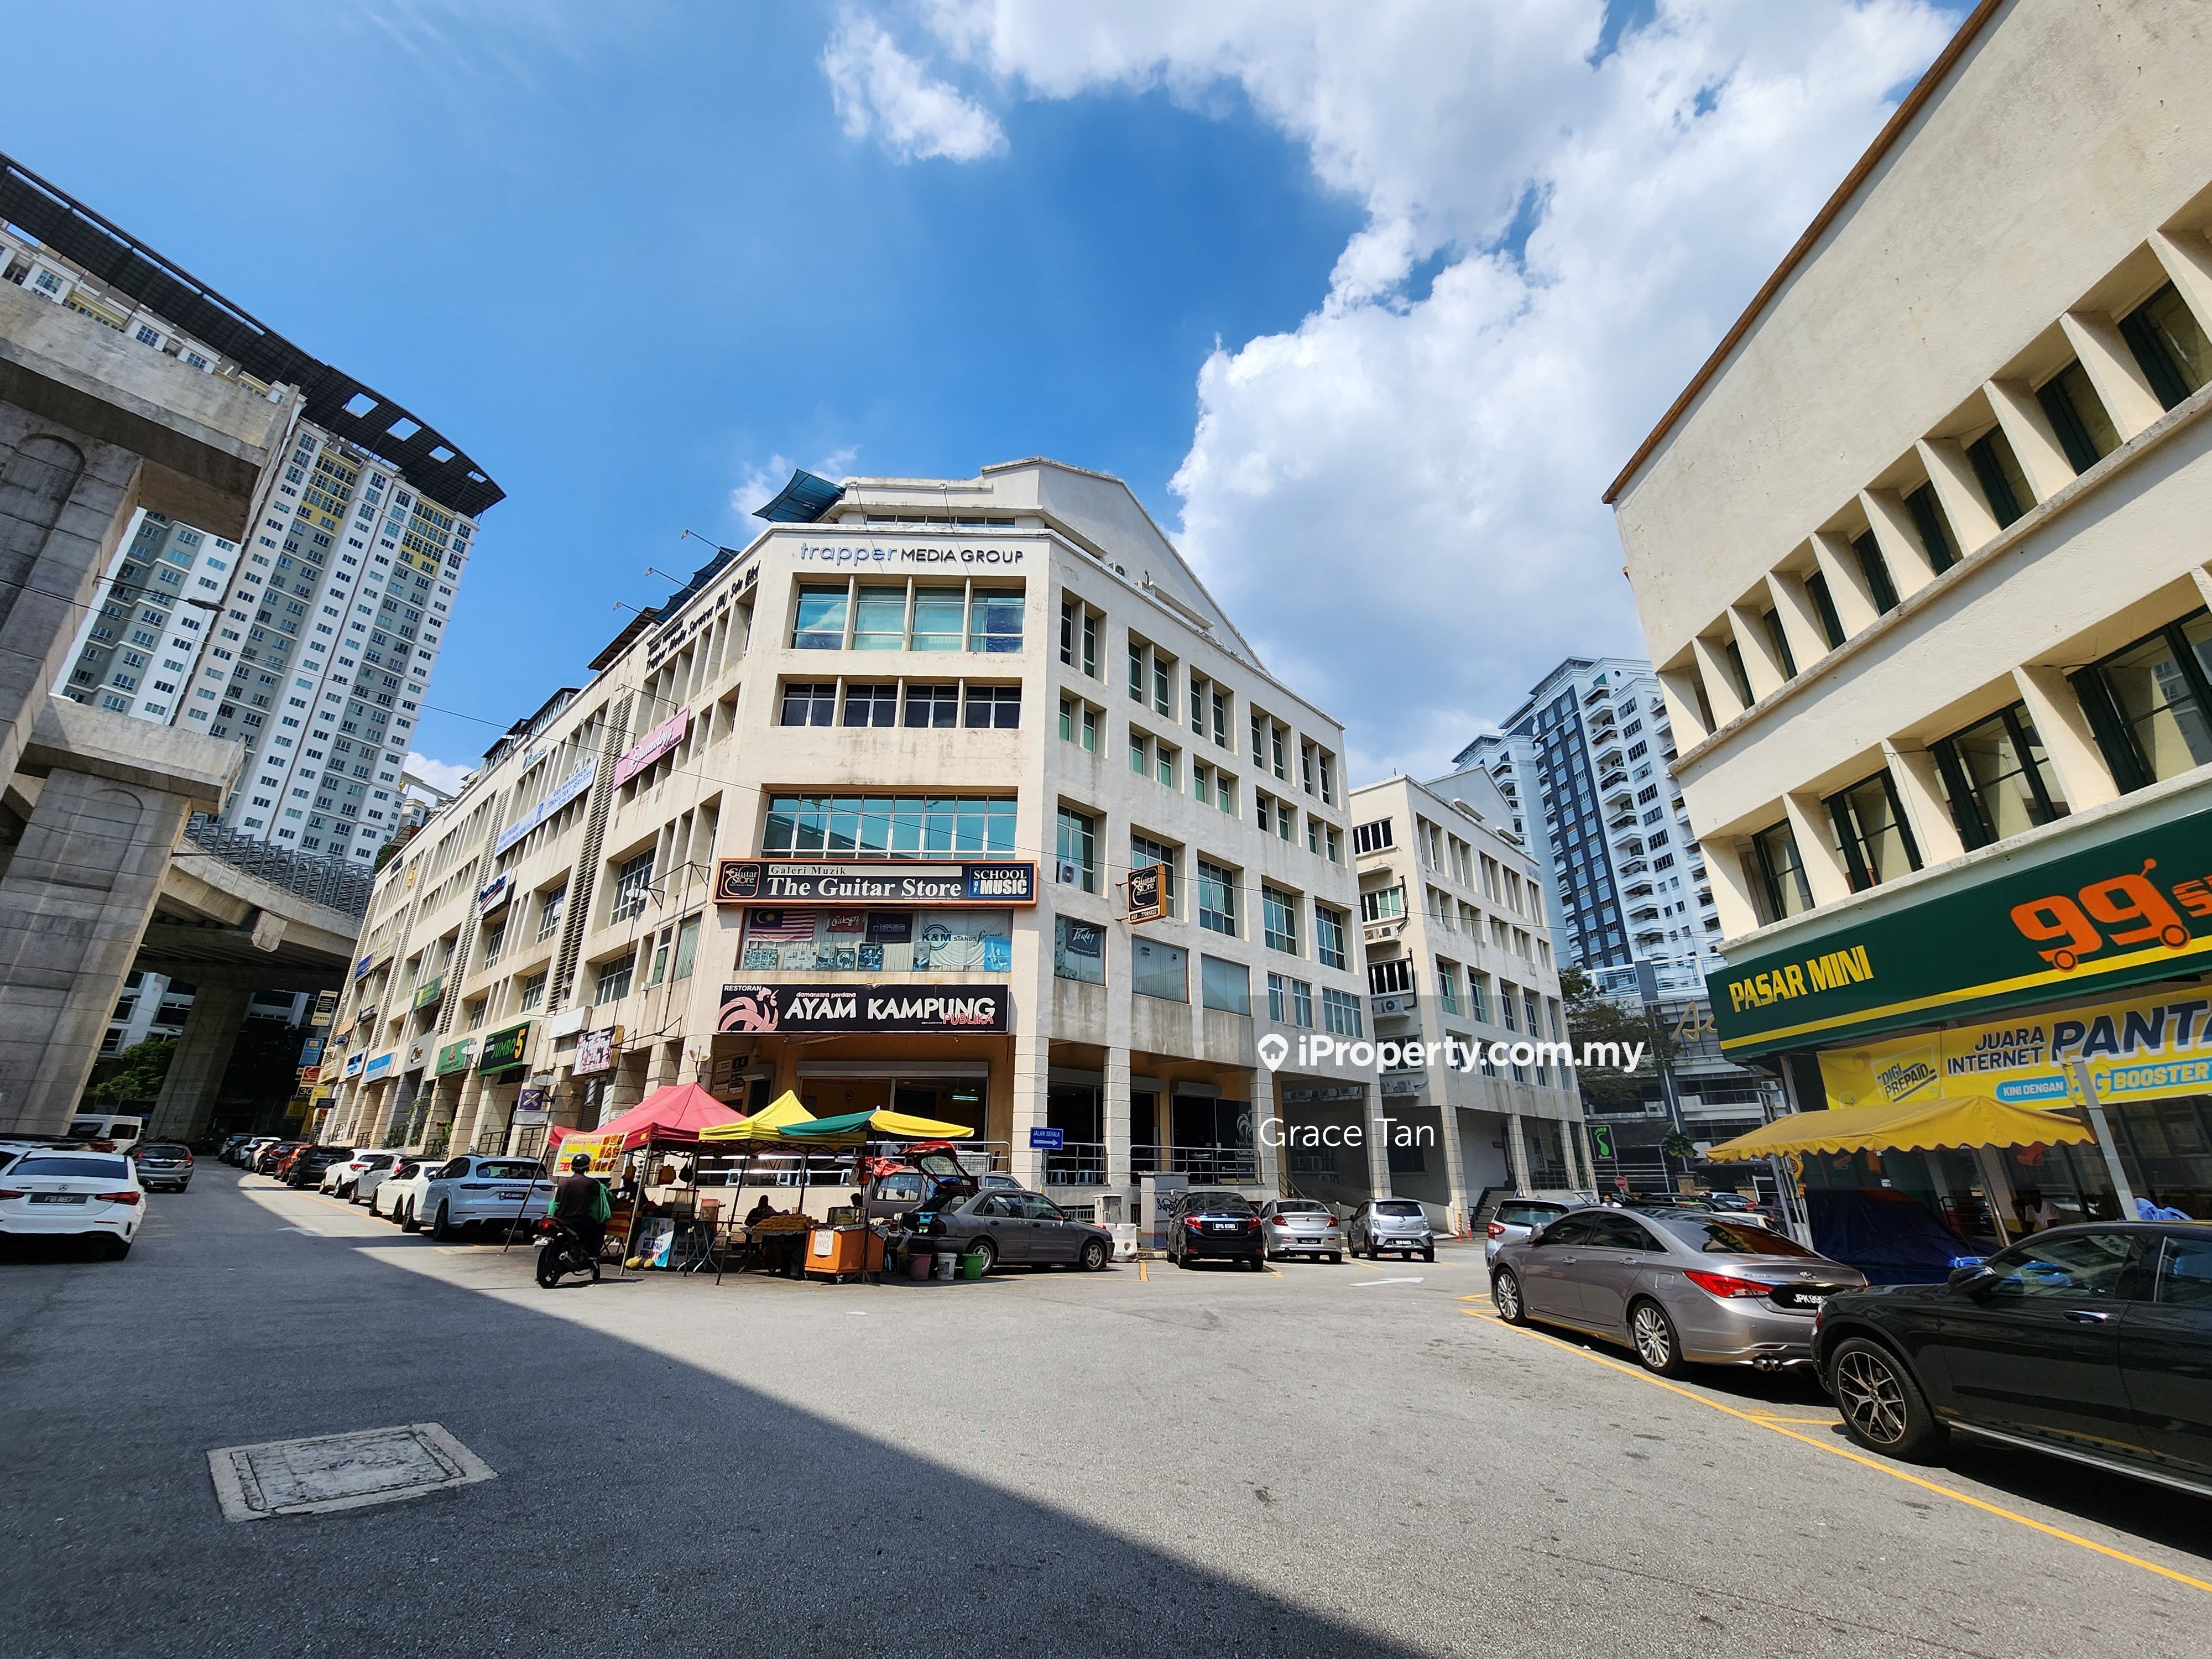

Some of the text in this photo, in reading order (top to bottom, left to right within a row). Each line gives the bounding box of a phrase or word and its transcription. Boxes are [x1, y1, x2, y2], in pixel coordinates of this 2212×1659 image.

[801, 542, 1024, 566] trapper MEDIA GROUP
[688, 606, 714, 635] Services
[730, 578, 743, 598] Sdn
[745, 560, 761, 589] Bhd
[732, 876, 754, 884] Store
[771, 866, 846, 875] Galeri Muzik
[973, 869, 1027, 879] SCHOOL
[1132, 876, 1156, 886] Guitar
[767, 878, 962, 897] The Guitar Store
[980, 879, 1027, 894] MUSIC
[1137, 883, 1155, 894] Store
[2010, 858, 2191, 972] 99
[922, 933, 951, 941] K&M
[974, 930, 988, 947] for
[1729, 945, 1874, 1013] PASAR MINI
[784, 997, 995, 1020] AYAM KAMPUNG
[943, 1013, 994, 1025] PUBLIKA
[1975, 1026, 2044, 1051] JUARA
[2052, 1000, 2212, 1061] PANT
[491, 1037, 516, 1059] JUMBO
[1947, 1046, 2043, 1074] INTERNET
[1881, 1063, 1902, 1086] DIGI
[1884, 1064, 1928, 1099] PREPAID
[2003, 1086, 2022, 1097] KINI
[2023, 1082, 2063, 1094] DENGAN
[2114, 1062, 2209, 1089] BOOSTER
